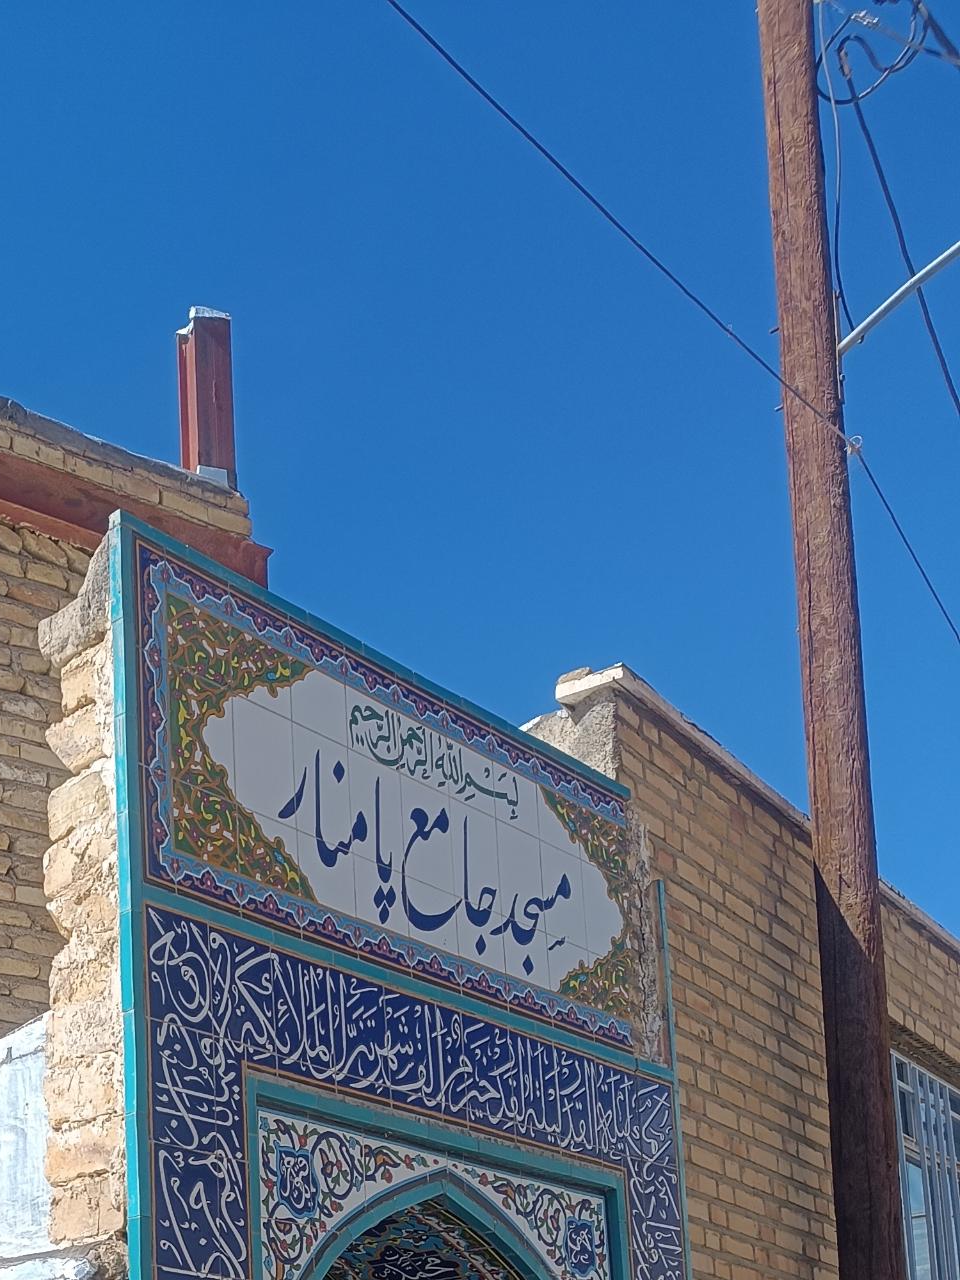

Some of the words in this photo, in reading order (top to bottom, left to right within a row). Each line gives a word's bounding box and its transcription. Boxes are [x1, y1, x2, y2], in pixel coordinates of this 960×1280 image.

[366, 726, 433, 776] الرحمن
[435, 742, 463, 787] الله
[456, 772, 519, 820] بسم
[402, 808, 497, 956] جامع
[490, 873, 572, 976] مسجد
